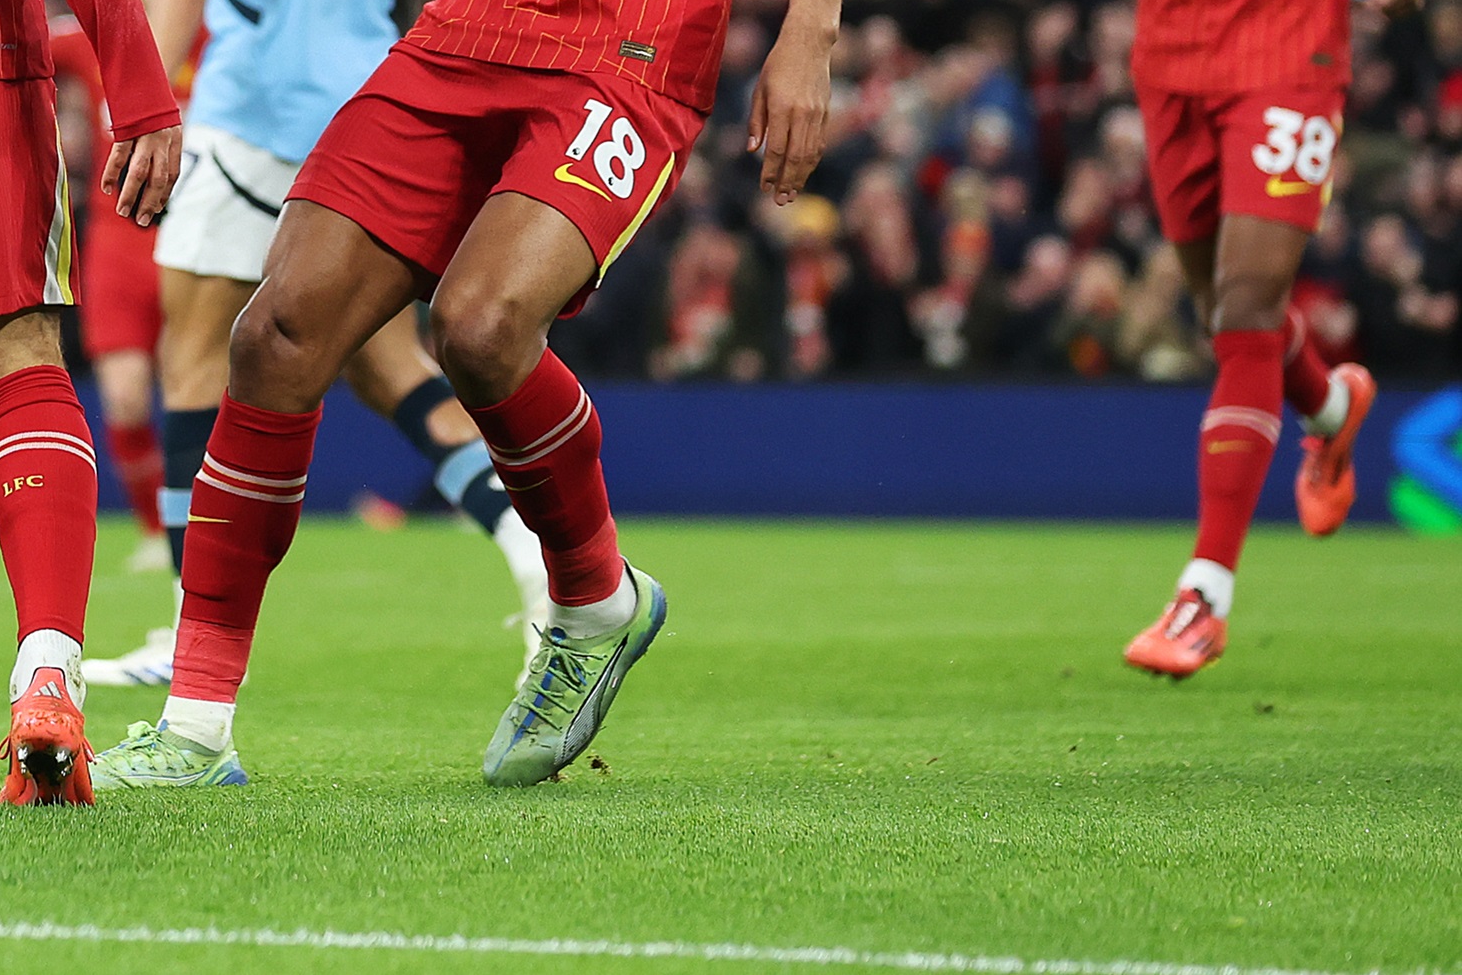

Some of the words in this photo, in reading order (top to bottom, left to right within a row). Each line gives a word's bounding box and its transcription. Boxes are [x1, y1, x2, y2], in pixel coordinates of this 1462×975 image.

[565, 98, 646, 199] 18
[1251, 105, 1337, 186] 38
[2, 474, 44, 498] LFC
